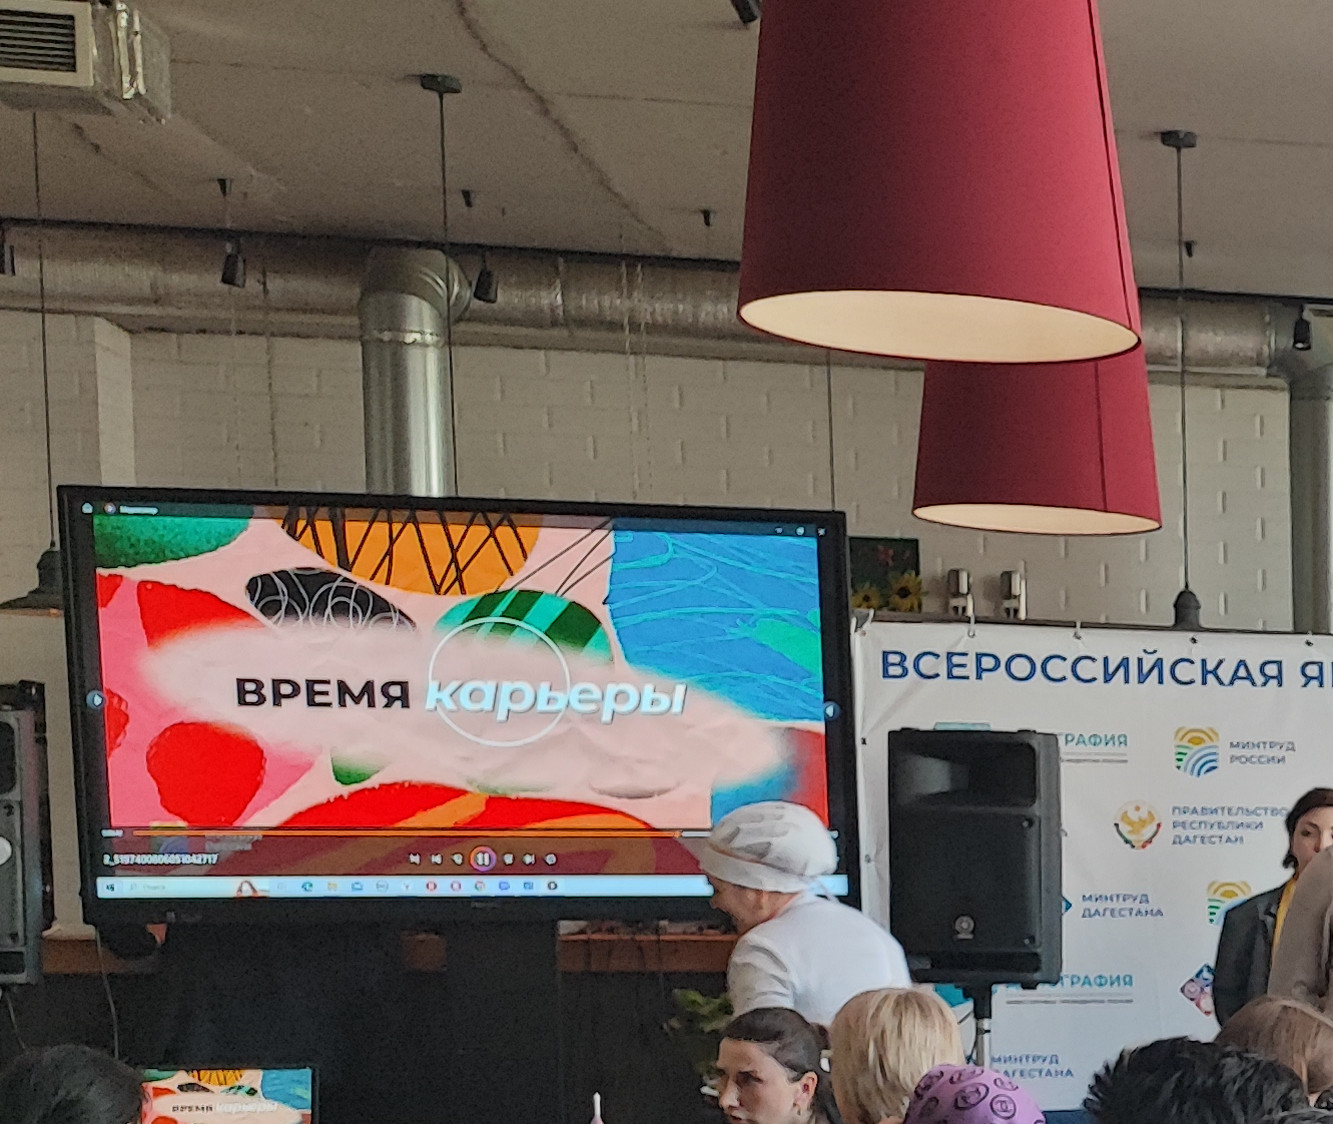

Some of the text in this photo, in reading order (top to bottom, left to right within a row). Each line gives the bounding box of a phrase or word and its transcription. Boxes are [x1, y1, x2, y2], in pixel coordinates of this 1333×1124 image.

[881, 648, 1283, 688] ВСЕРОССИЙСКАЯ
[235, 677, 688, 725] ВРЕМЯ карьеры
[1229, 740, 1296, 753] МИНТРУД
[1229, 754, 1286, 765] РОССИИ
[1172, 820, 1264, 831] РЕСПУБЛИКИ
[1172, 834, 1244, 846] ДАГЕСТАН
[1081, 893, 1150, 905] МИНТРУД
[1081, 907, 1164, 919] ДАГЕСТАНА
[1003, 1068, 1074, 1079] АГЕСТАНА
